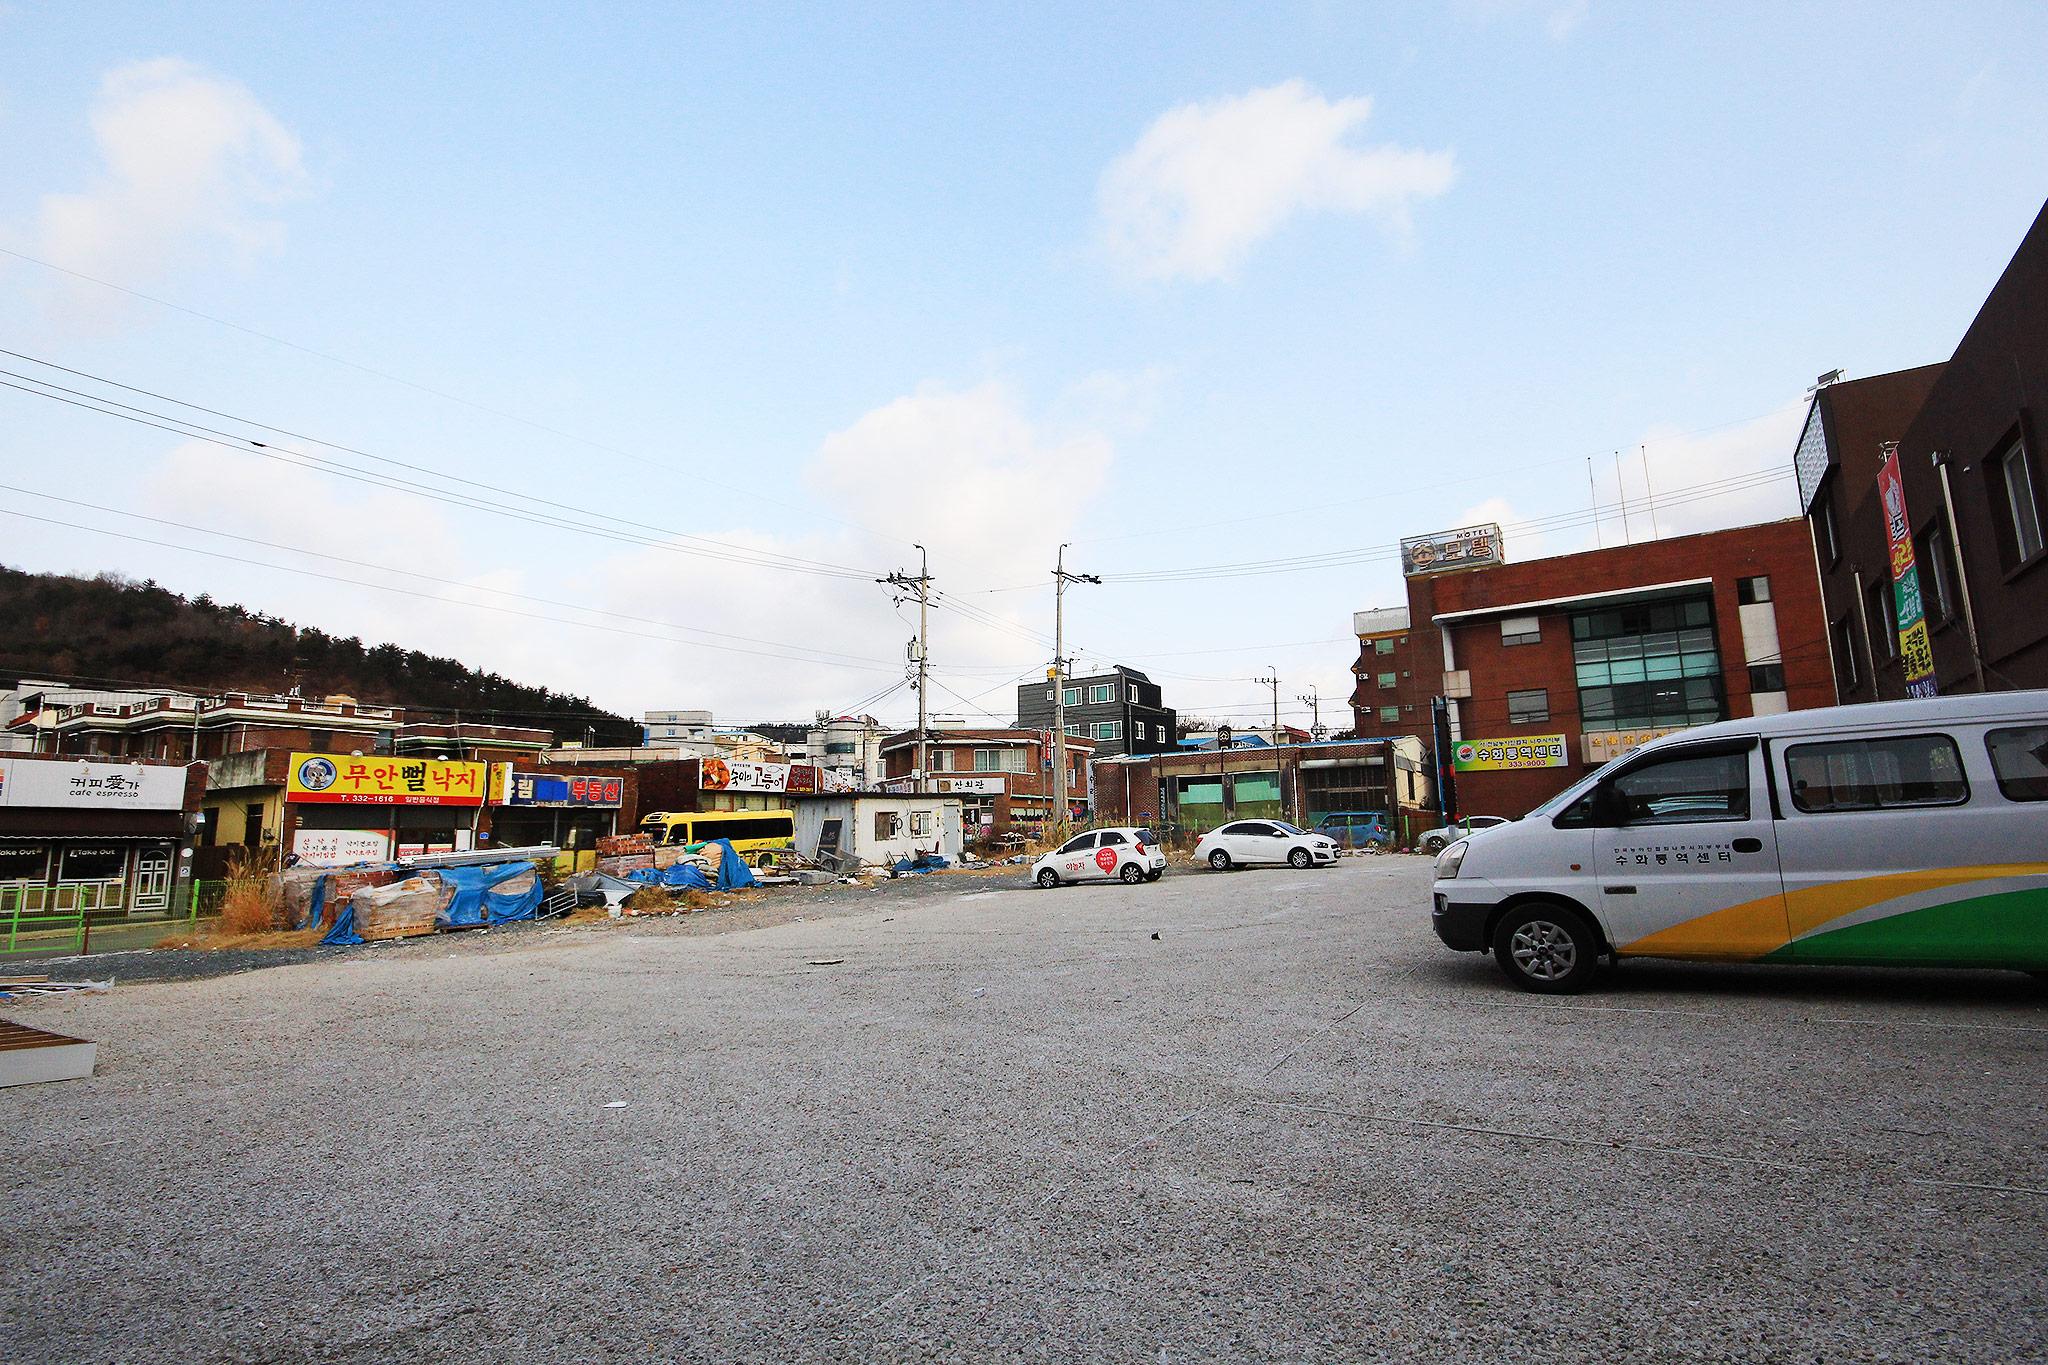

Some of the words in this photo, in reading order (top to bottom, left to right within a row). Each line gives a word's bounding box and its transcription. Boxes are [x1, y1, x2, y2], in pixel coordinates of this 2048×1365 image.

[1456, 529, 1488, 539] MOTEL
[1478, 744, 1562, 761] 수화통역센터
[751, 766, 784, 789] 고등어
[96, 790, 138, 798] espresso
[352, 794, 394, 802] 332-1616
[571, 780, 619, 801] 부동산
[1616, 851, 1732, 866] 수화통역센터
